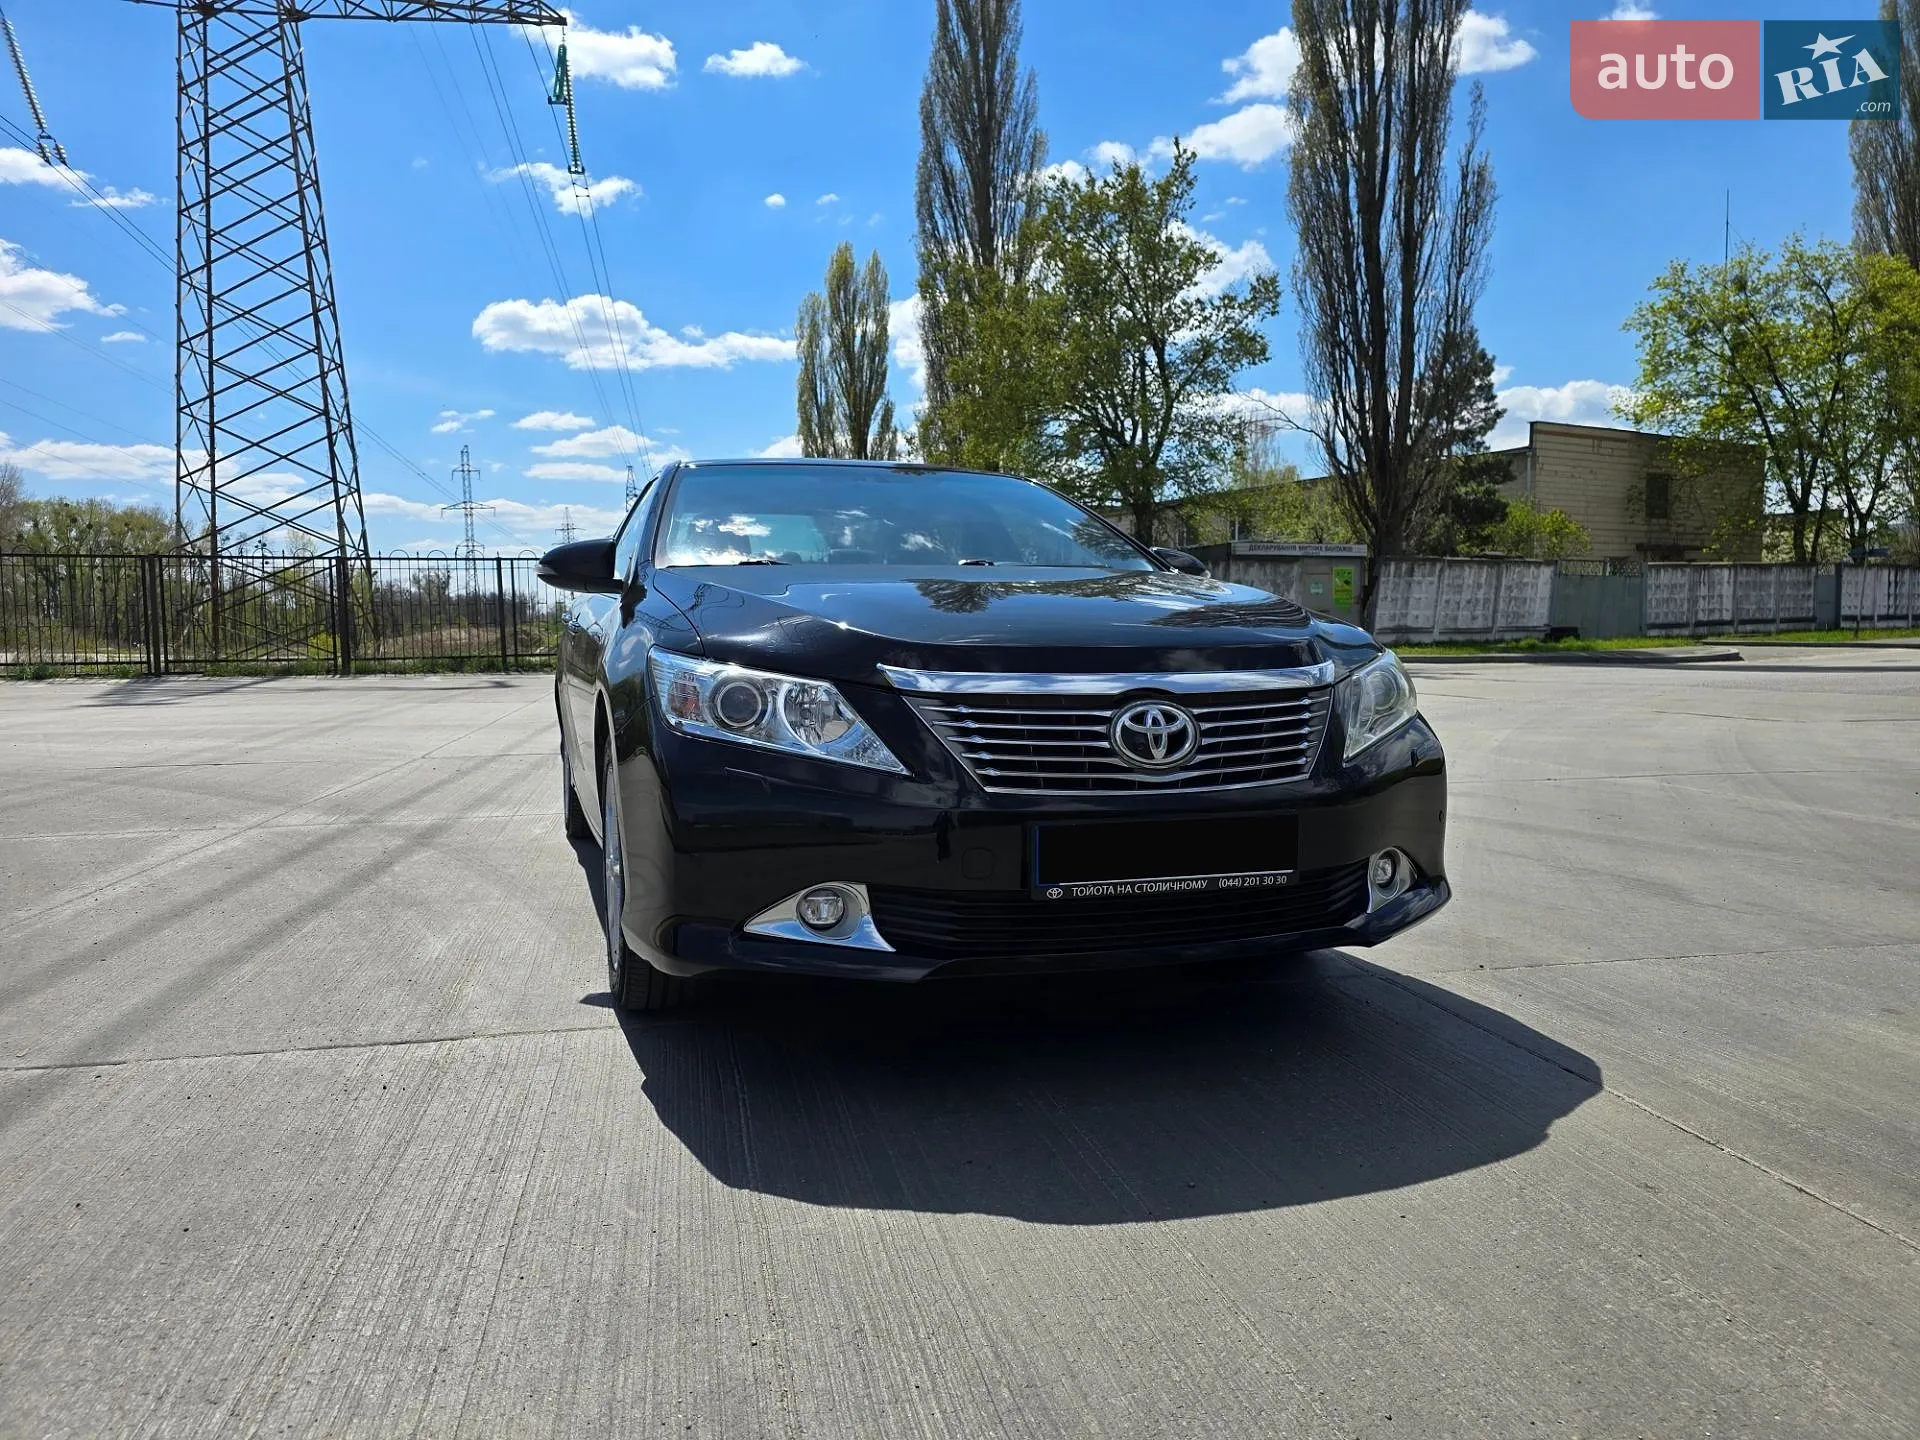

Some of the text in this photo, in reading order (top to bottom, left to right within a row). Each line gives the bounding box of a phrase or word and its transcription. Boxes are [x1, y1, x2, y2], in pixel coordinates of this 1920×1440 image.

[1072, 875, 1287, 897] ТОЙОТА НА СТОЛИЧНОМУ (044) 201 30 30
